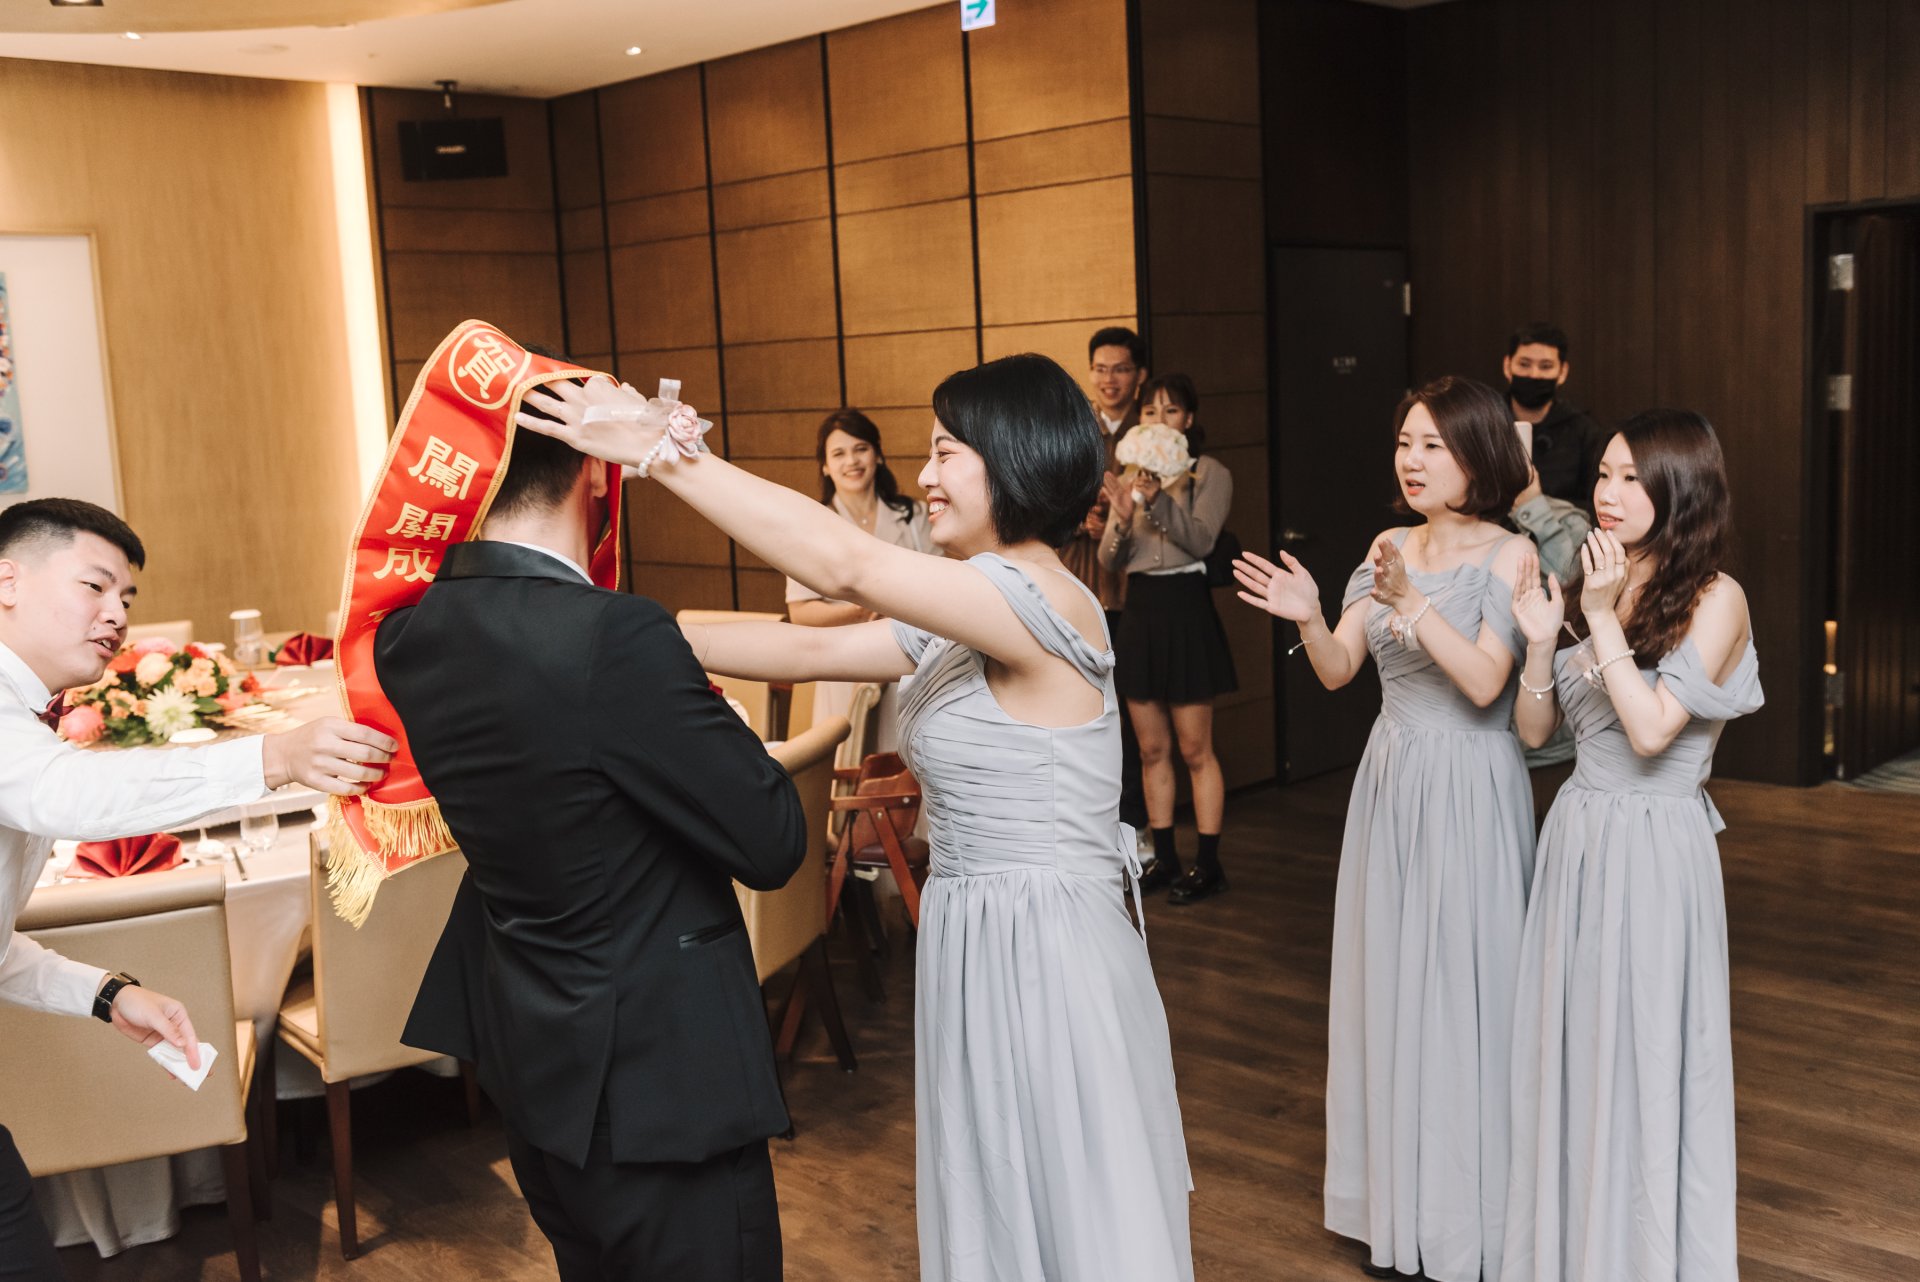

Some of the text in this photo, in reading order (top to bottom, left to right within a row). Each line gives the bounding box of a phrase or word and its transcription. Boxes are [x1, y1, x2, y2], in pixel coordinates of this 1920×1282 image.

[458, 335, 517, 400] 賀
[364, 435, 480, 624] 闖關成
